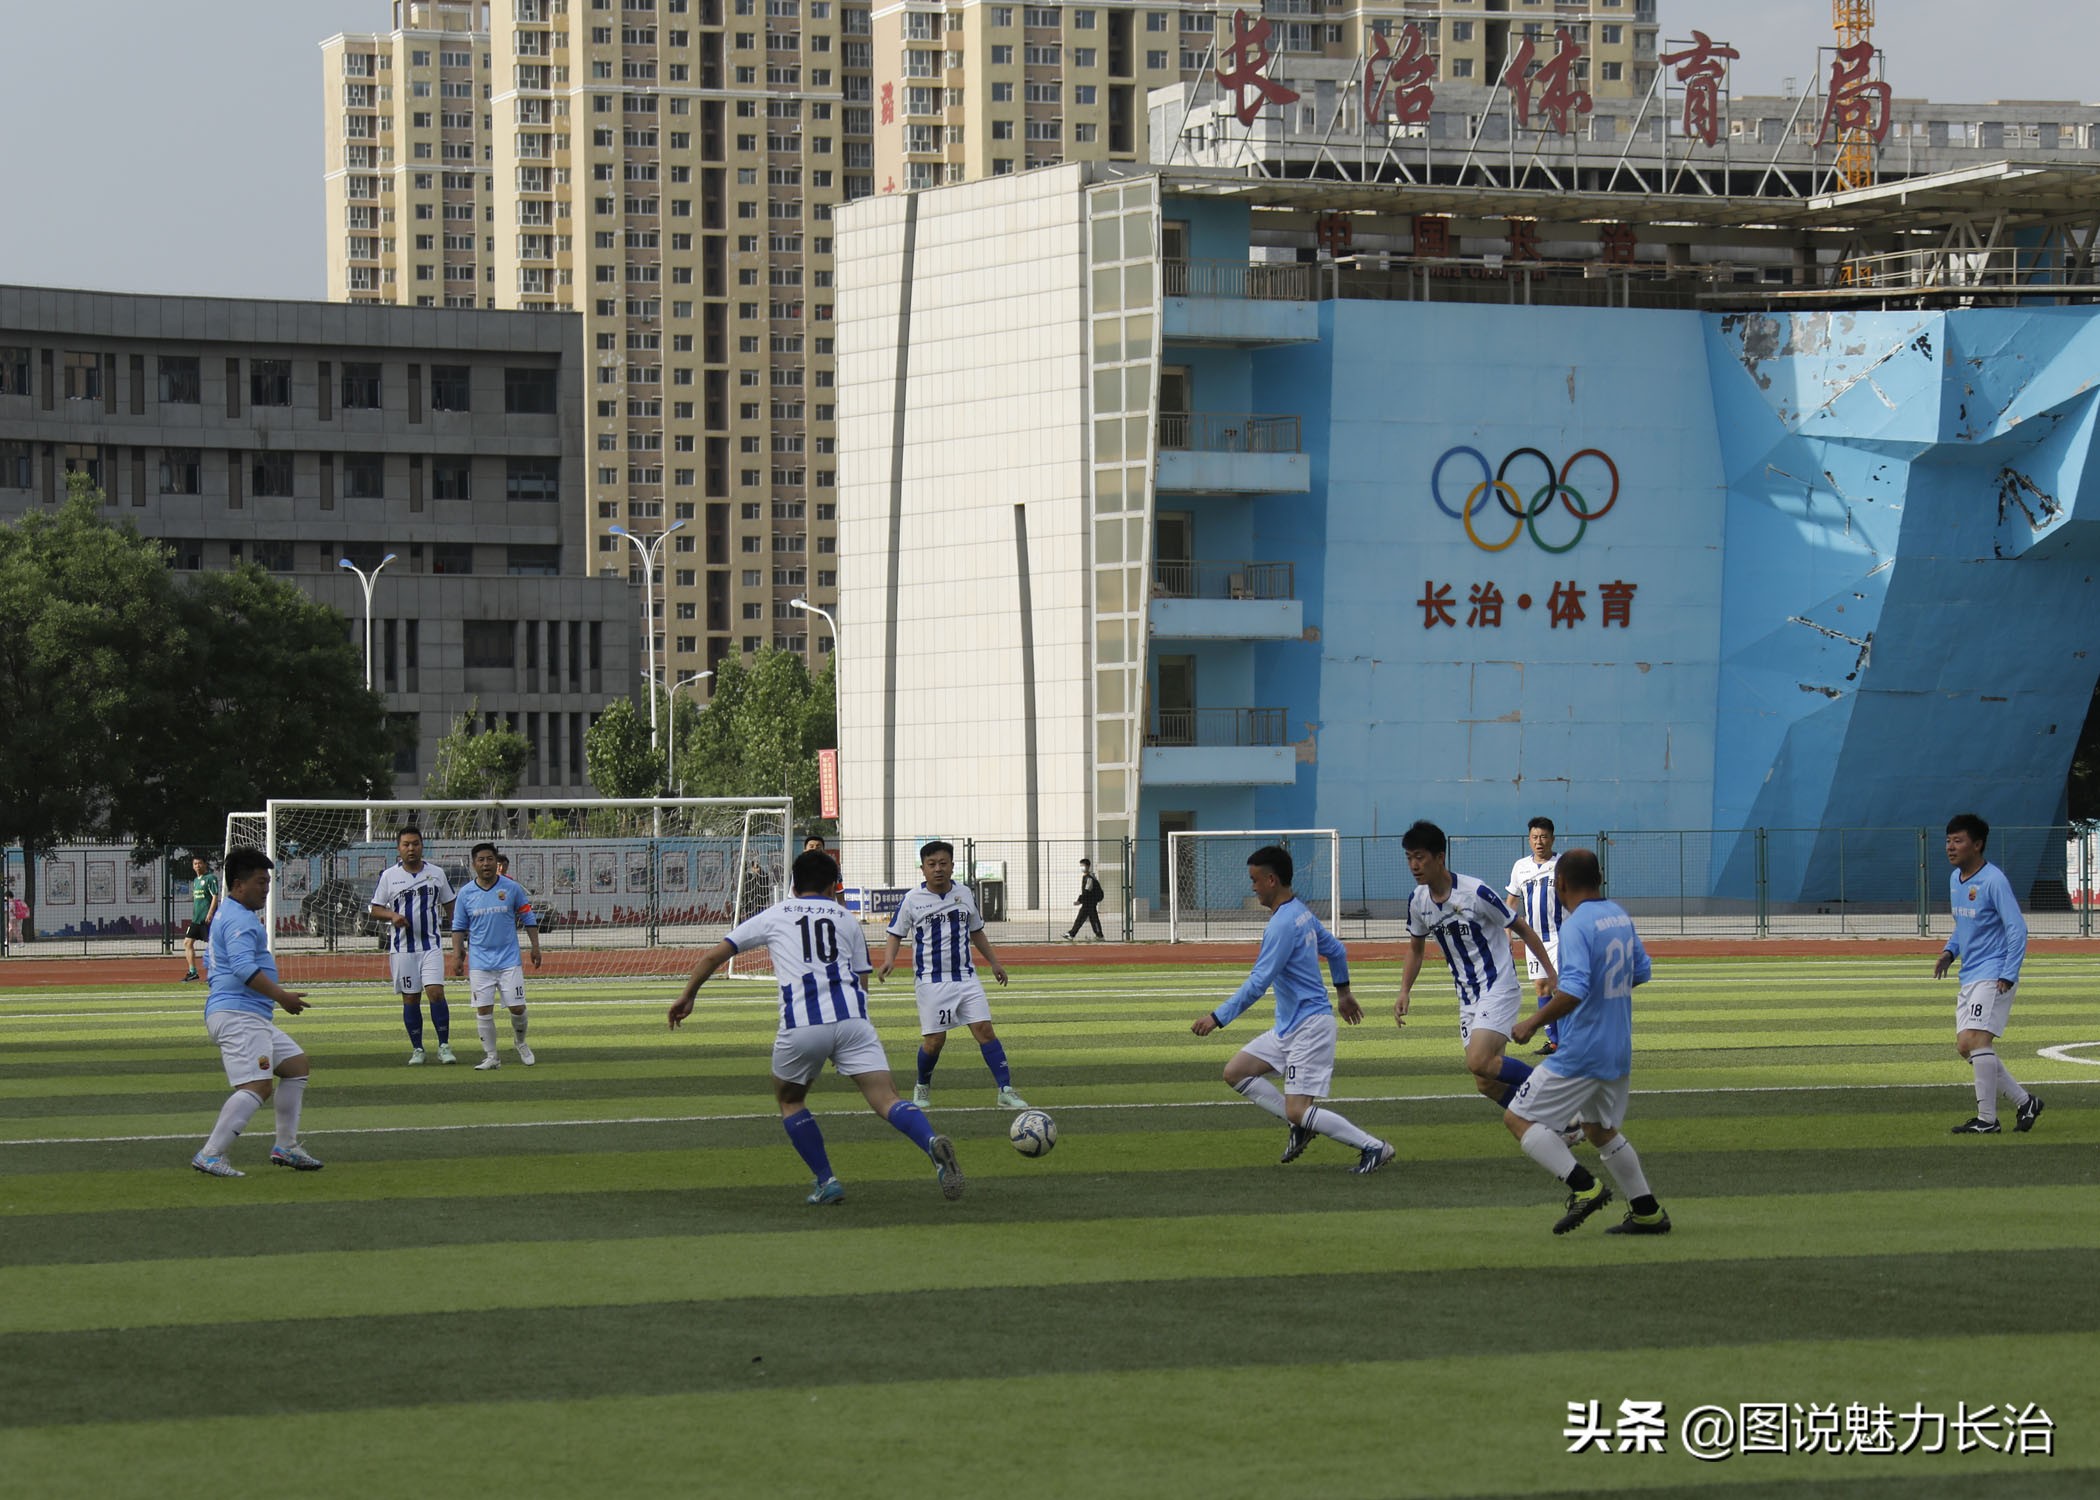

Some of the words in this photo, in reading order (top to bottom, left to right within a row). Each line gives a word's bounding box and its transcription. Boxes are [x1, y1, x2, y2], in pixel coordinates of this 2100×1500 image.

[1216, 9, 1892, 148] 长治体育局
[1316, 213, 1638, 263] 中国长治
[1417, 580, 1637, 629] 长治·体育
[795, 915, 838, 963] 10
[1529, 961, 1539, 974] 27
[403, 976, 412, 989] 15
[515, 986, 524, 996] 10
[940, 1009, 951, 1025] 21
[1971, 1004, 1982, 1017] 18
[1286, 1065, 1296, 1080] 0
